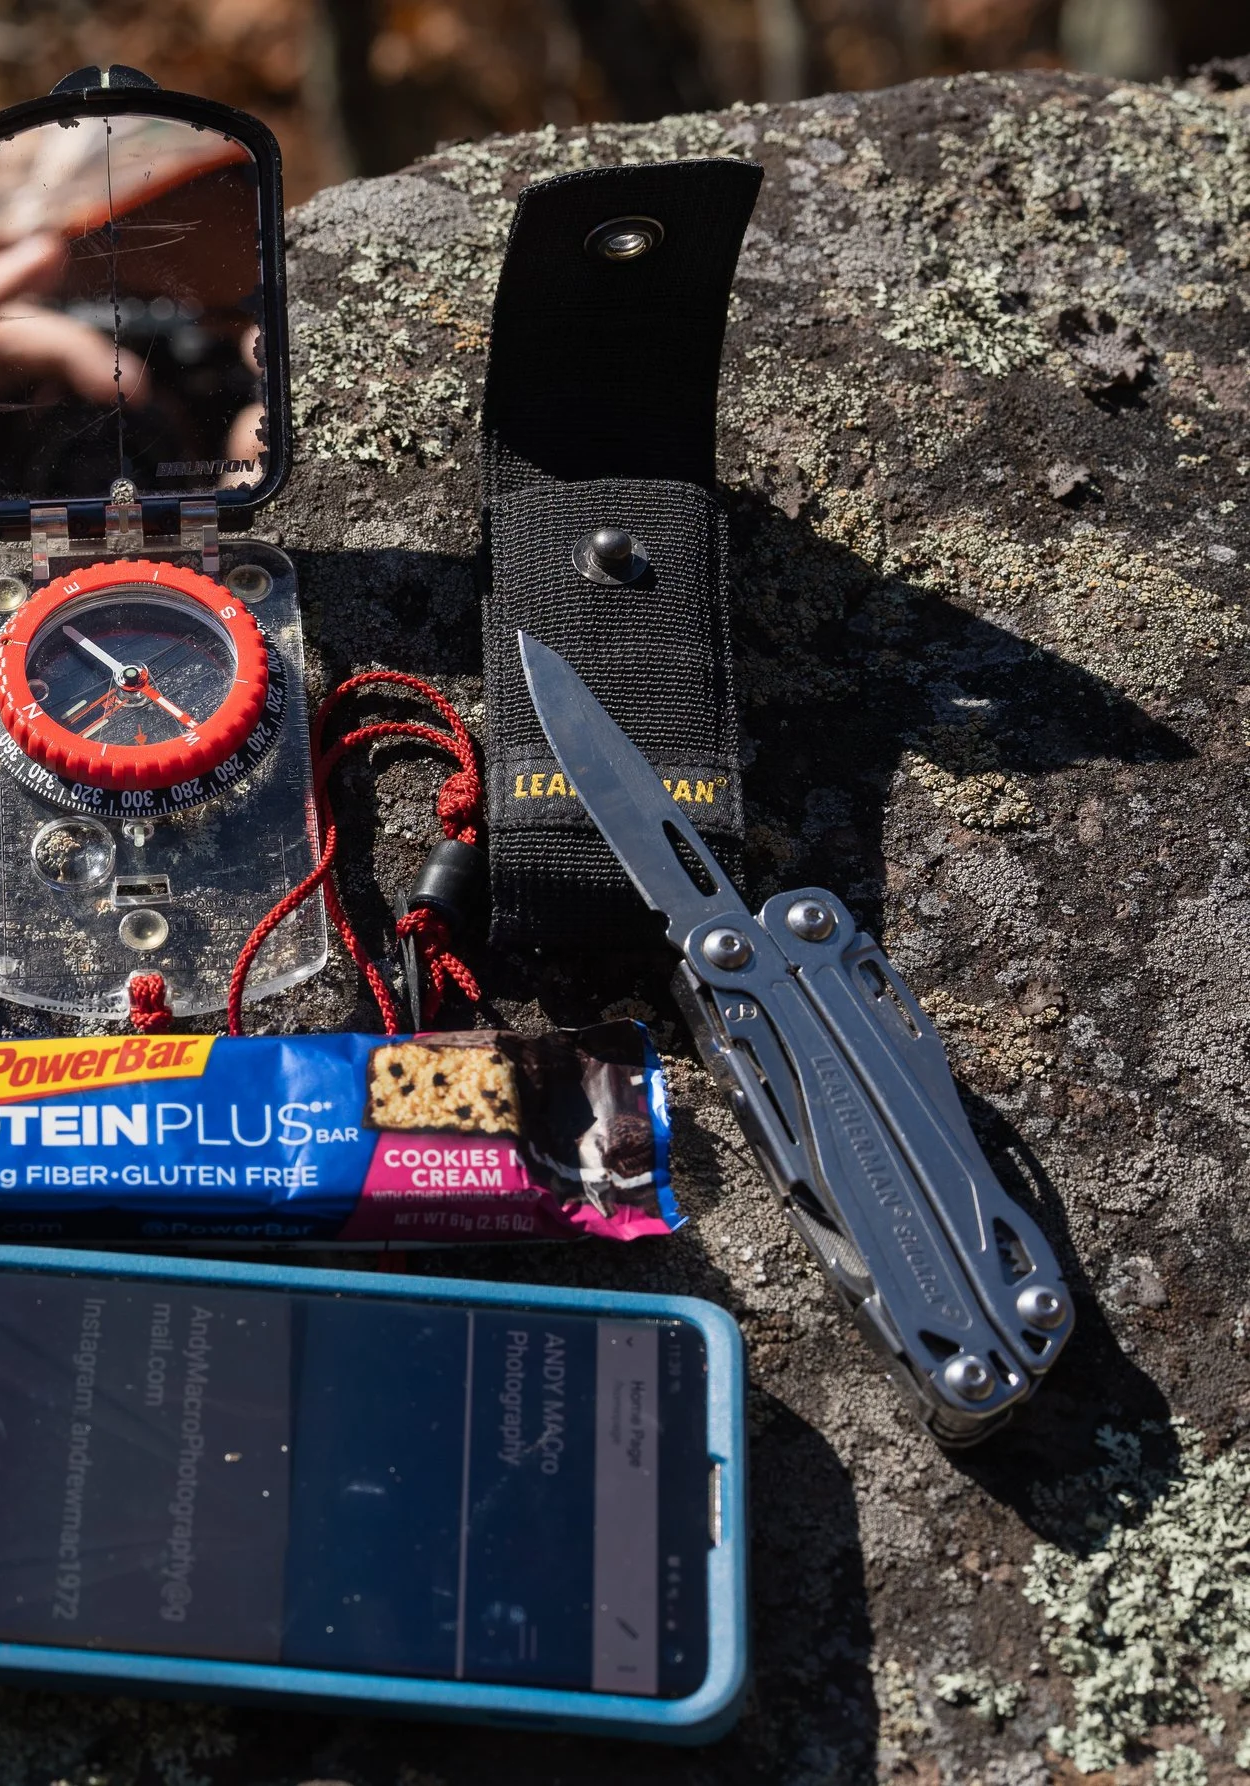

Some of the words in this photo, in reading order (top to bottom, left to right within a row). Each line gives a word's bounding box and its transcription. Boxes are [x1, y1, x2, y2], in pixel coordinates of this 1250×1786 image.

[155, 459, 256, 477] BRUNTON
[63, 581, 80, 595] E
[219, 606, 237, 620] S
[22, 702, 43, 720] N
[265, 683, 283, 713] 220
[246, 721, 272, 752] 240
[28, 763, 58, 790] 340
[214, 753, 244, 783] 260
[70, 783, 104, 805] 320
[121, 790, 154, 808] 300
[170, 777, 204, 802] 280
[513, 772, 715, 804] LEAAN
[315, 1127, 359, 1144] BAR
[811, 1054, 900, 1208] LEATHERMAN
[383, 1149, 500, 1168] COOKIES
[246, 1165, 319, 1188] FREE
[411, 1168, 503, 1188] CREAM
[394, 1213, 419, 1226] NET
[423, 1212, 447, 1226] WT
[146, 1302, 174, 1407] mail.com
[542, 1331, 566, 1396] ANDY
[497, 1329, 528, 1467] Photography
[630, 1380, 645, 1426] Home
[540, 1400, 564, 1476] MACro
[626, 1429, 645, 1469] Page
[159, 1304, 213, 1623] AndyMacroPhotography@g
[52, 1422, 92, 1621] andrewmac1972
